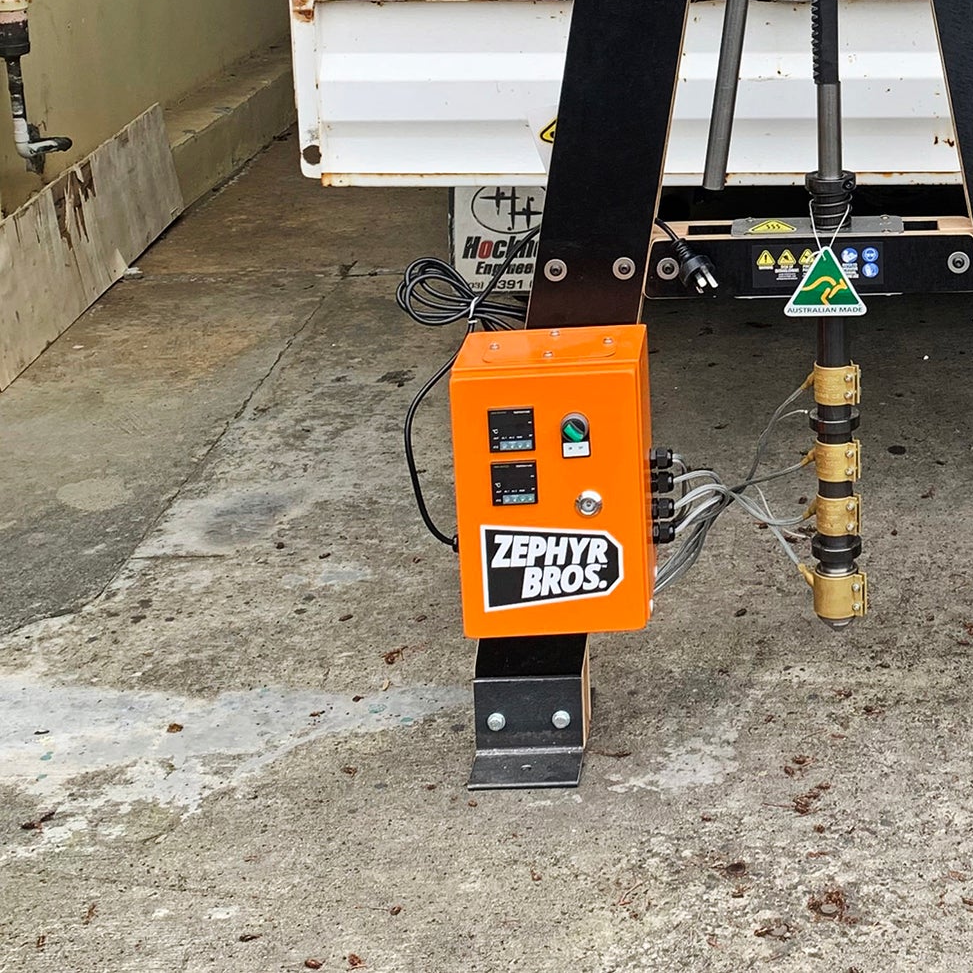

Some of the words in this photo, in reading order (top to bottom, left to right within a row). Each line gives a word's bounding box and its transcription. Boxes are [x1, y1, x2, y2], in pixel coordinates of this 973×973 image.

[497, 279, 524, 290] 391
[491, 534, 609, 568] ZEPHYR
[521, 564, 608, 599] BROS.
